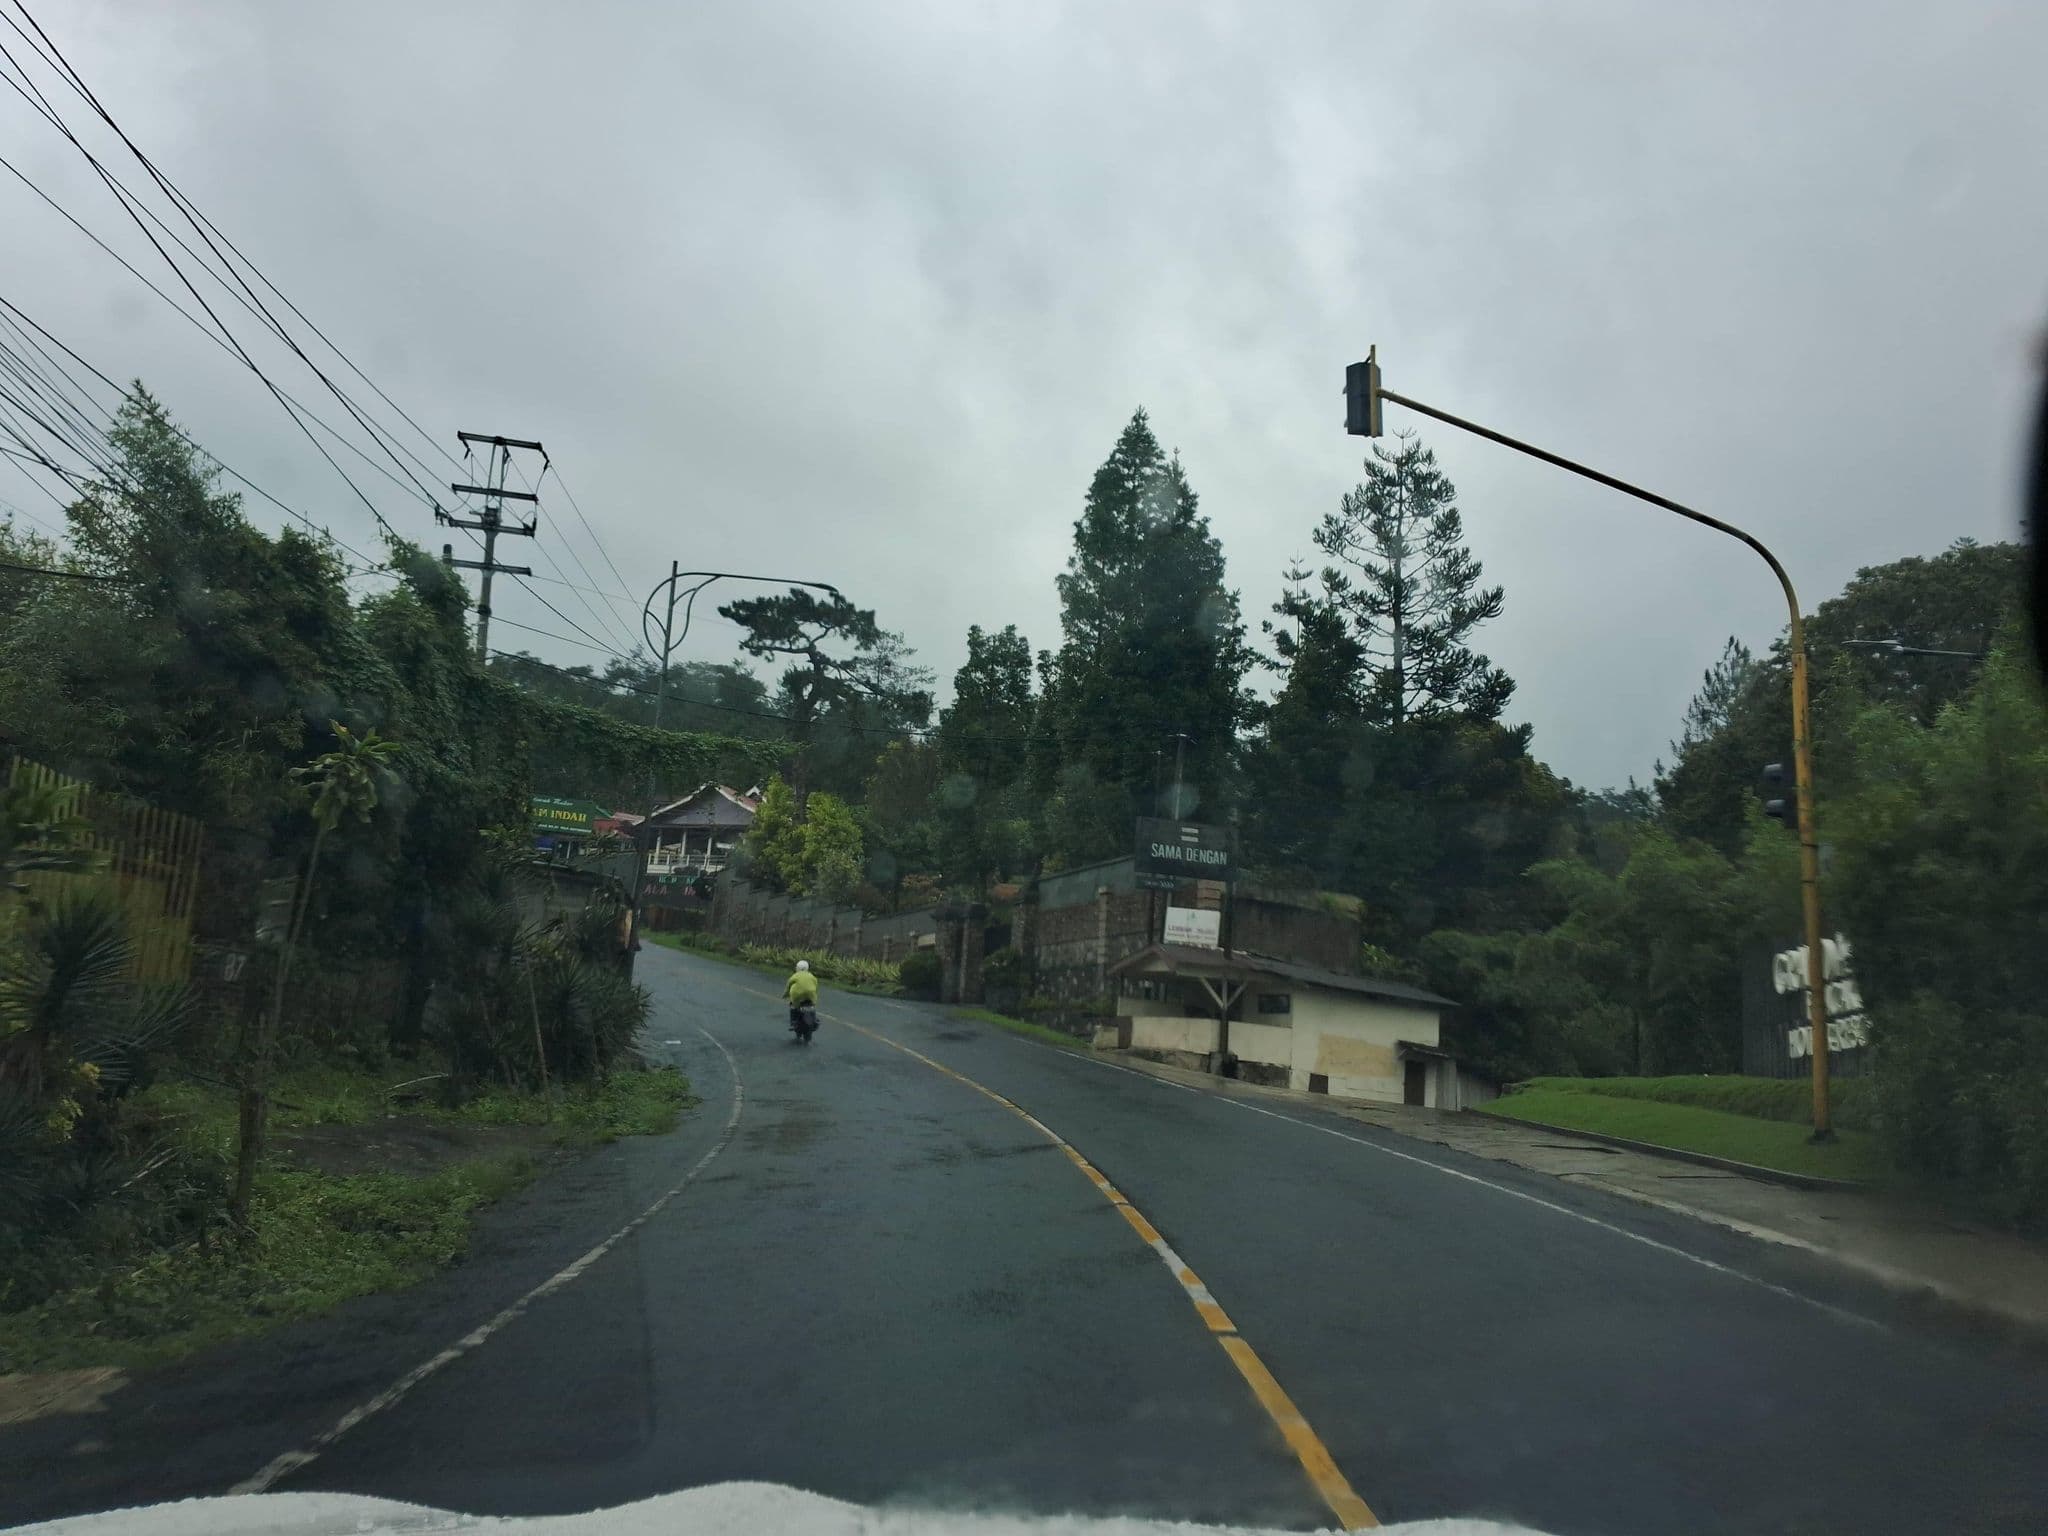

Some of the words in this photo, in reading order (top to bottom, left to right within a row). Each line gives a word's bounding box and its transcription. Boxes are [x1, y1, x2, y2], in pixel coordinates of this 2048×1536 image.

[551, 810, 587, 822] INDAH
[1151, 843, 1181, 860] SAMA
[1186, 848, 1227, 865] DENGAN
